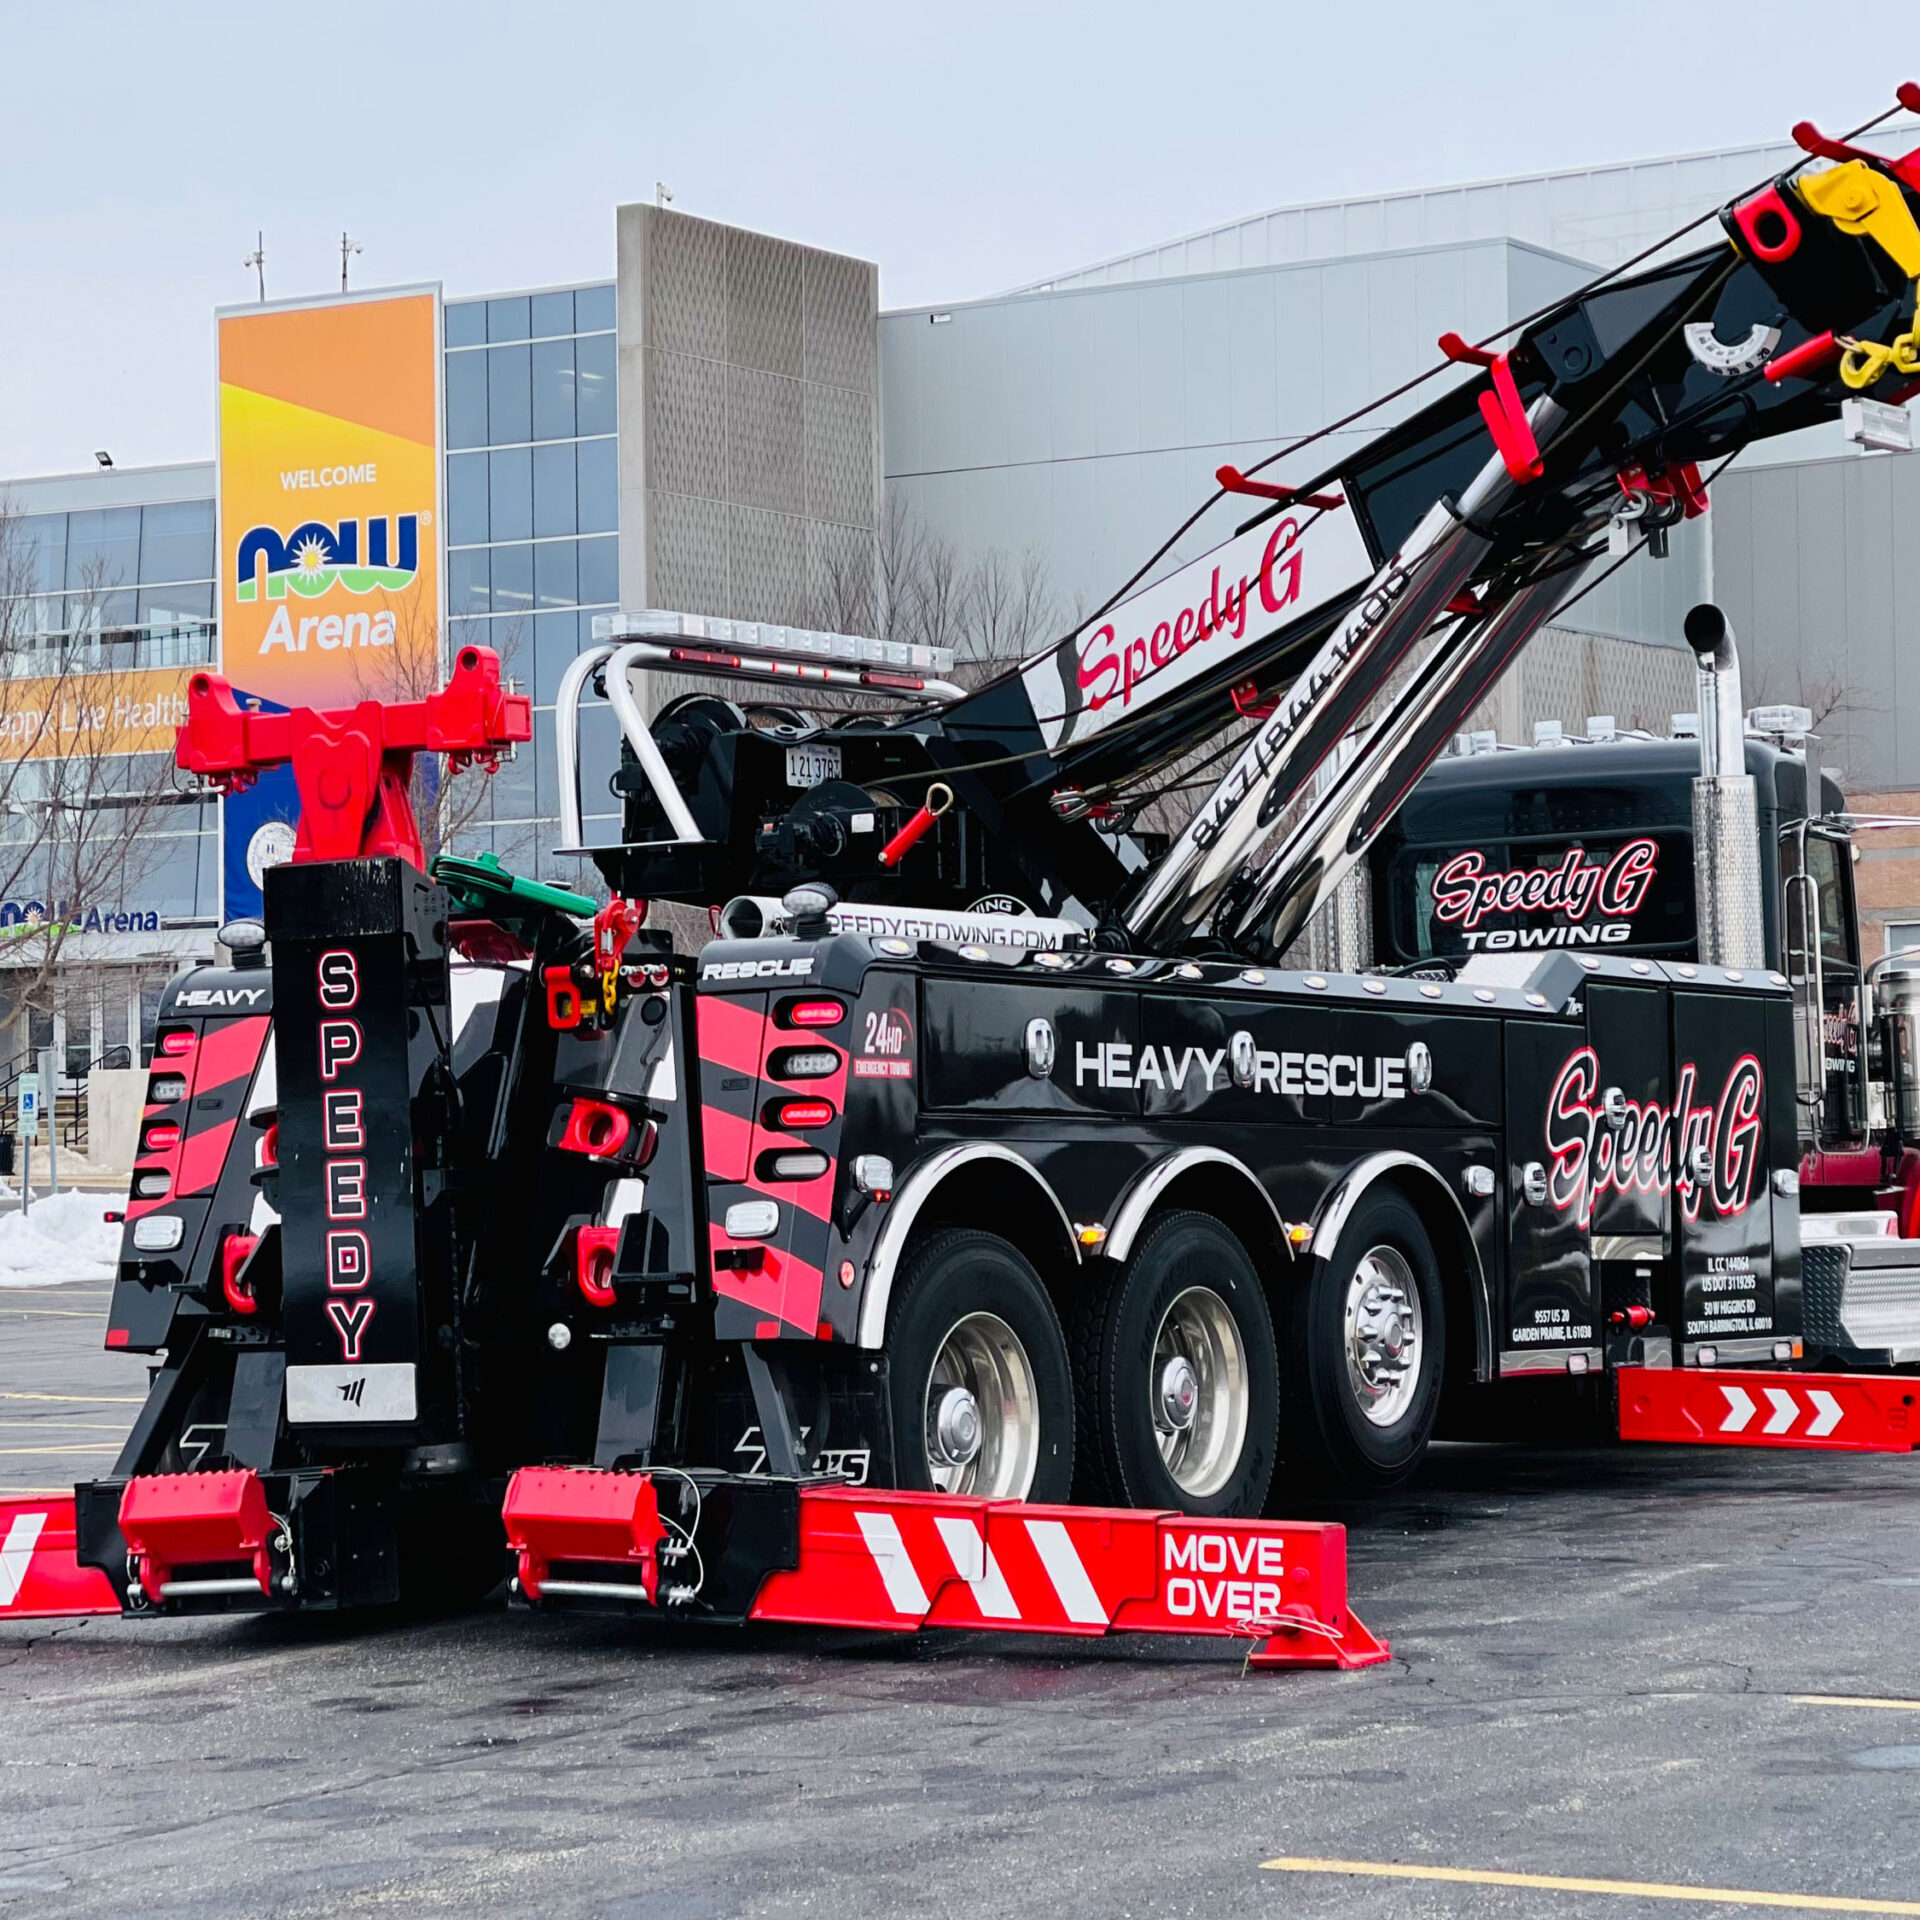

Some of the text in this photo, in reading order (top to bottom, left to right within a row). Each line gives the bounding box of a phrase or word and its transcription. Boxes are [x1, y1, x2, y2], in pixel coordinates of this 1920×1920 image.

[281, 463, 377, 491] WELCOME
[1076, 516, 1304, 711] Speedy G
[258, 604, 397, 654] Arena
[1431, 837, 1659, 928] Speedy G
[83, 906, 160, 934] Arena
[826, 914, 1057, 950] PEEDYGTOWING.COM
[1461, 923, 1632, 951] TOWING
[702, 957, 815, 981] RESCUE
[175, 987, 267, 1008] HEAVY
[855, 1060, 911, 1076] EMERGENCY TOWING
[1075, 1040, 1407, 1099] HEAVY RESCUE
[1824, 1057, 1856, 1073] OWING
[1545, 1045, 1763, 1231] Speedy G
[317, 948, 376, 1361] SPEEDY
[1715, 1256, 1725, 1272] CC
[1701, 1277, 1712, 1292] US
[1713, 1275, 1728, 1291] DOT
[1534, 1309, 1570, 1323] 9557 US 20
[1713, 1301, 1720, 1315] W
[1720, 1300, 1746, 1314] HIGGINS
[1746, 1299, 1756, 1313] RD
[1512, 1327, 1540, 1342] GARDEN
[1540, 1326, 1566, 1341] PRAIRIE,
[1566, 1326, 1572, 1339] IL
[1687, 1320, 1709, 1335] SOUTH
[1749, 1317, 1755, 1331] IL
[1164, 1533, 1285, 1577] MOVE
[1167, 1577, 1282, 1625] OVER
